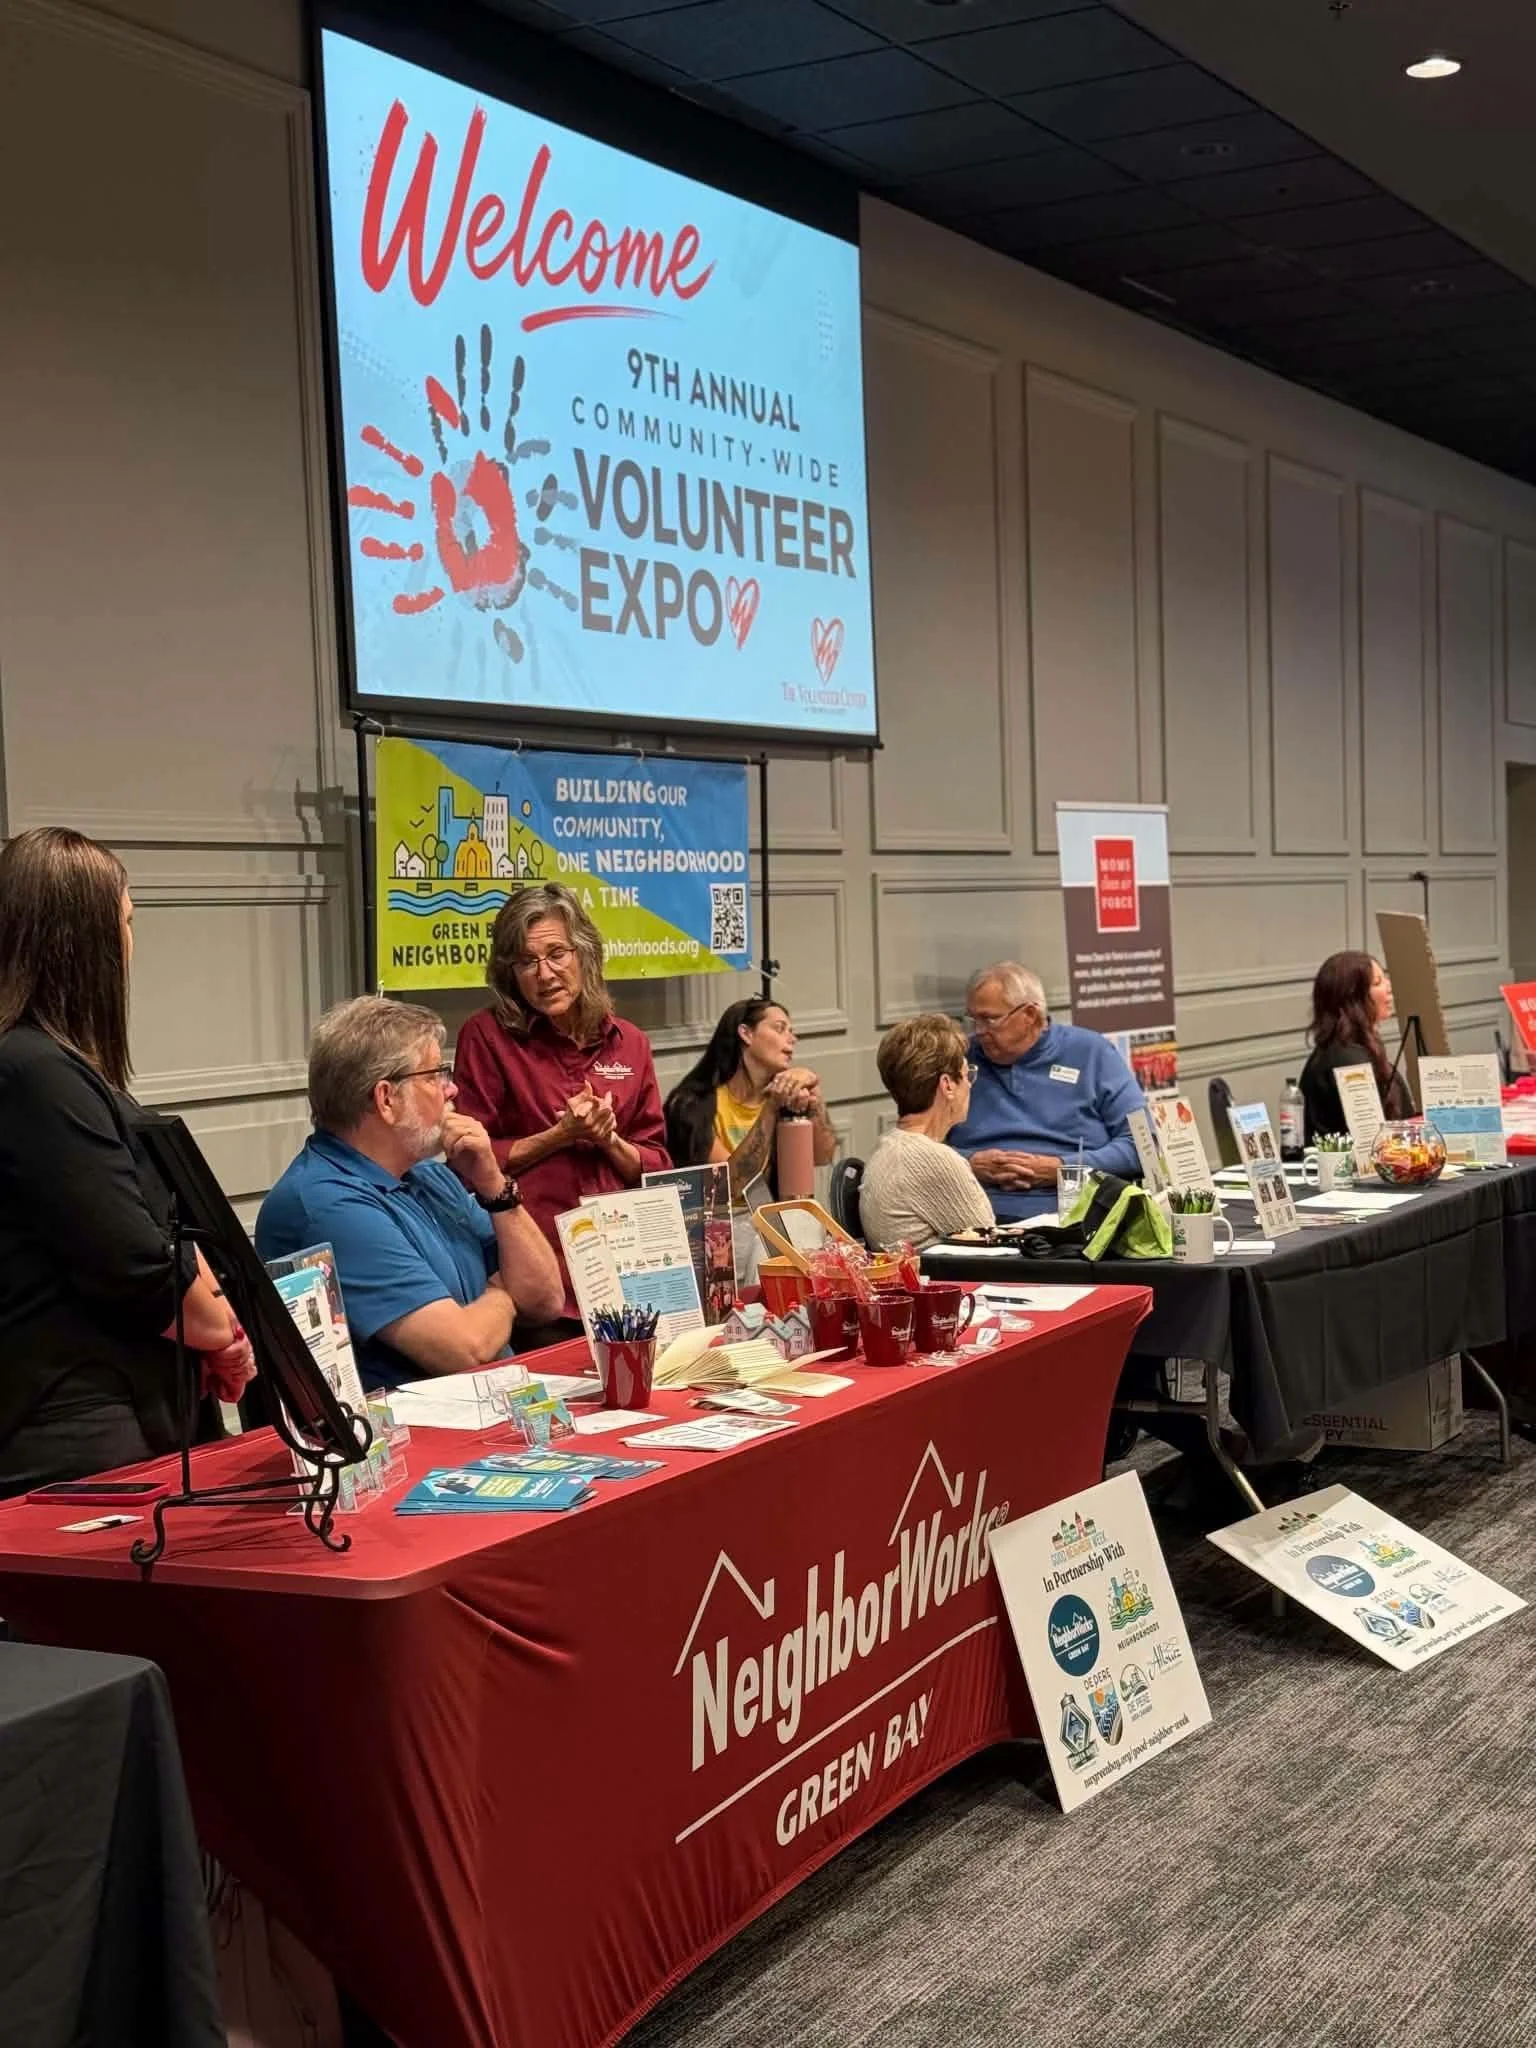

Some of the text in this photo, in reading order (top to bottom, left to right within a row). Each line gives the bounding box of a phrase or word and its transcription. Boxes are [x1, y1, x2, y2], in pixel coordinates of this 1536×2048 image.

[360, 98, 717, 306] Welcome
[627, 348, 801, 432] 9TH ANNUAL
[572, 397, 841, 488] COMMUNITY-WIDE
[573, 447, 856, 578] VOLUNTEER
[580, 547, 722, 646] EXPO
[556, 777, 687, 807] BUILDING OUR
[553, 816, 665, 842] COMMUNITY,
[558, 849, 745, 873] ONE NEIGHBORHOOD
[582, 888, 594, 909] A
[600, 887, 641, 908] TIME
[432, 923, 480, 940] GREEN
[602, 936, 700, 963] ghborhoods.org
[392, 944, 494, 967] NEIGHBOR
[1042, 1541, 1126, 1593] In Partnership With
[776, 1688, 934, 1847] GREEN BAY
